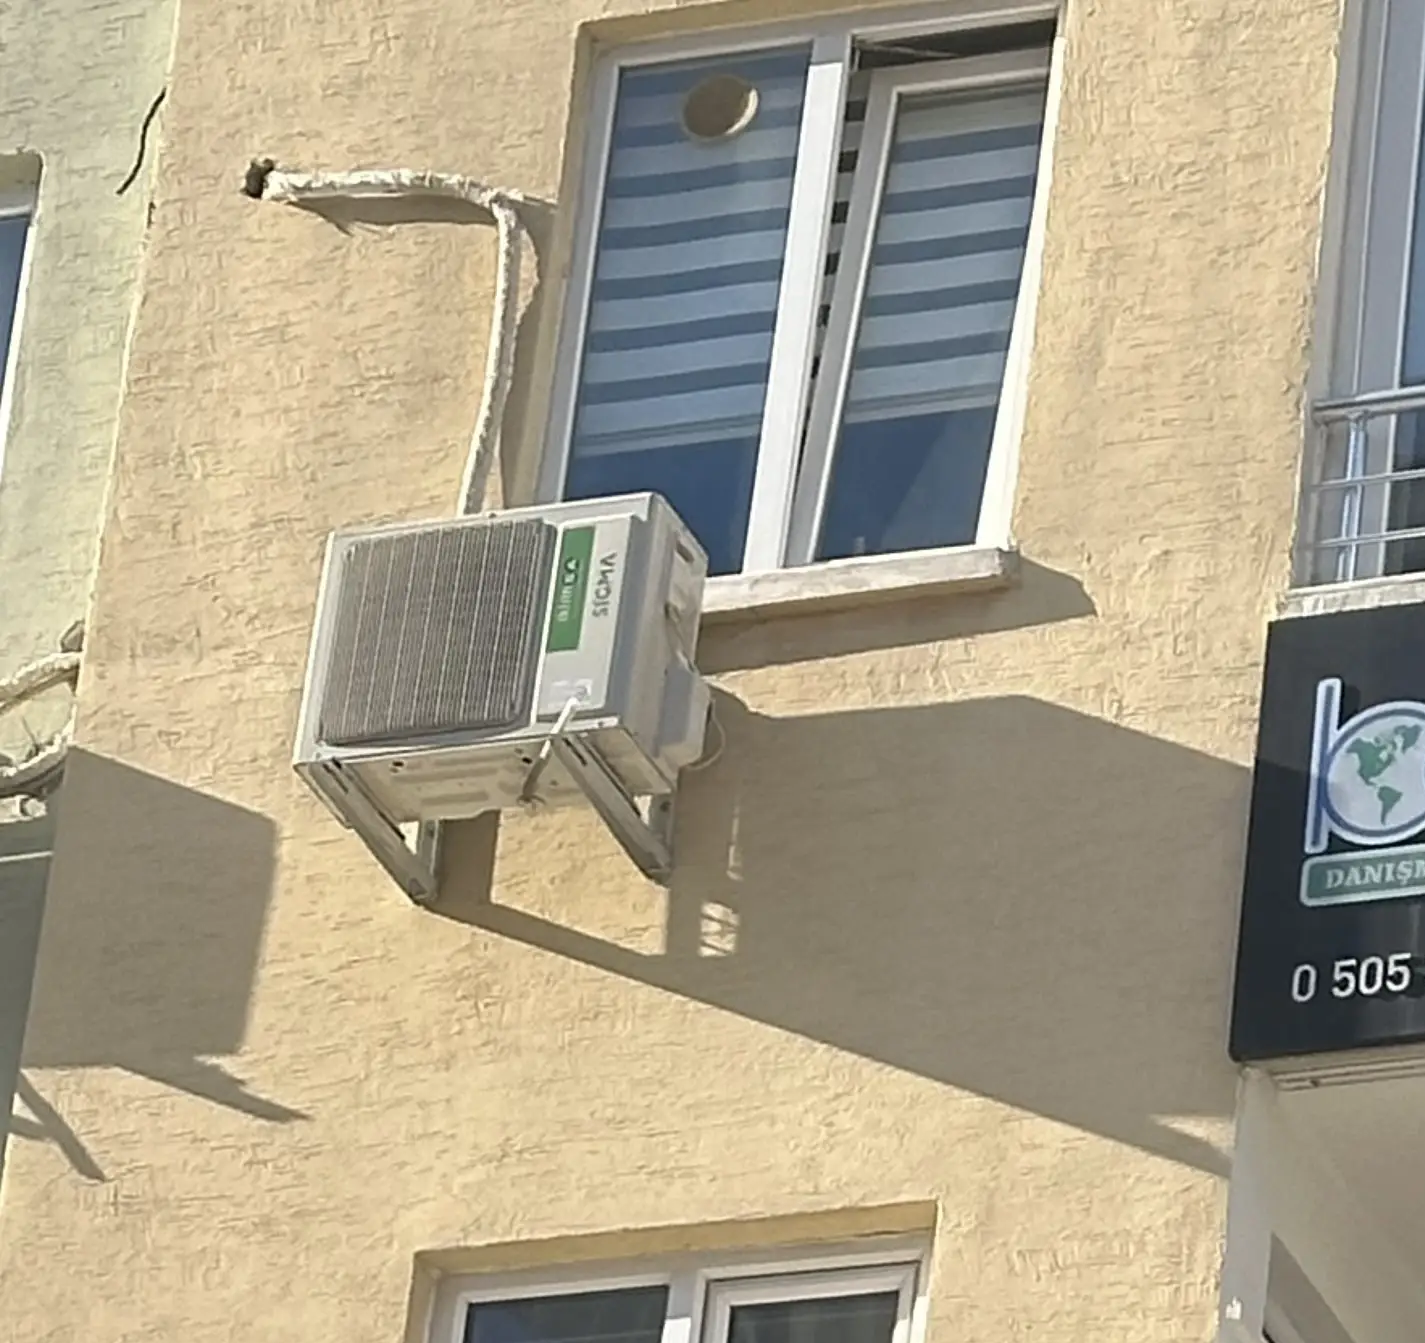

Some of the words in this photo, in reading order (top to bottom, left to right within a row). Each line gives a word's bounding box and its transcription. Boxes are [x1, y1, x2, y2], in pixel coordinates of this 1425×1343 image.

[594, 553, 617, 616] SIGMA
[1292, 965, 1316, 1002] 0
[1333, 953, 1411, 997] 505
